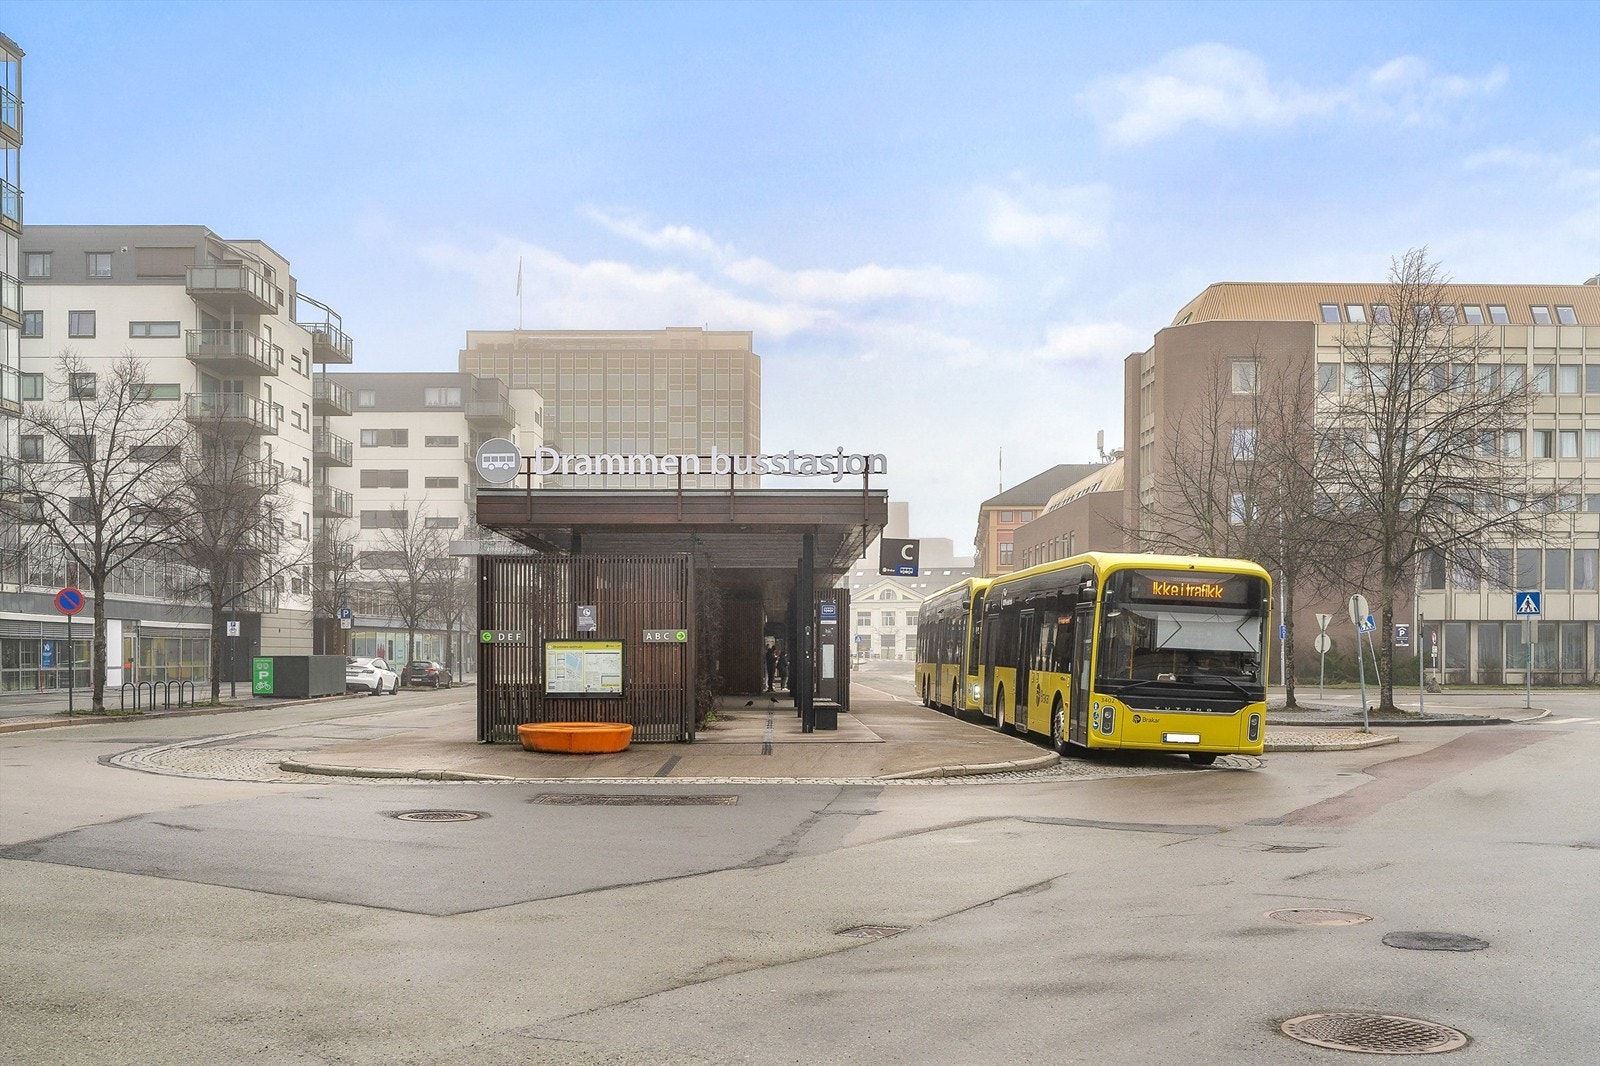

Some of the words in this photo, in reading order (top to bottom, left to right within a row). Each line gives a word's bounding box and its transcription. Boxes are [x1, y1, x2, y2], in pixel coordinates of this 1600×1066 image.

[535, 446, 700, 476] Drammen
[710, 445, 888, 483] busstasjon
[901, 544, 914, 560] C
[1152, 581, 1179, 596] Ikke
[1185, 583, 1224, 598] trafikk
[259, 671, 269, 680] P
